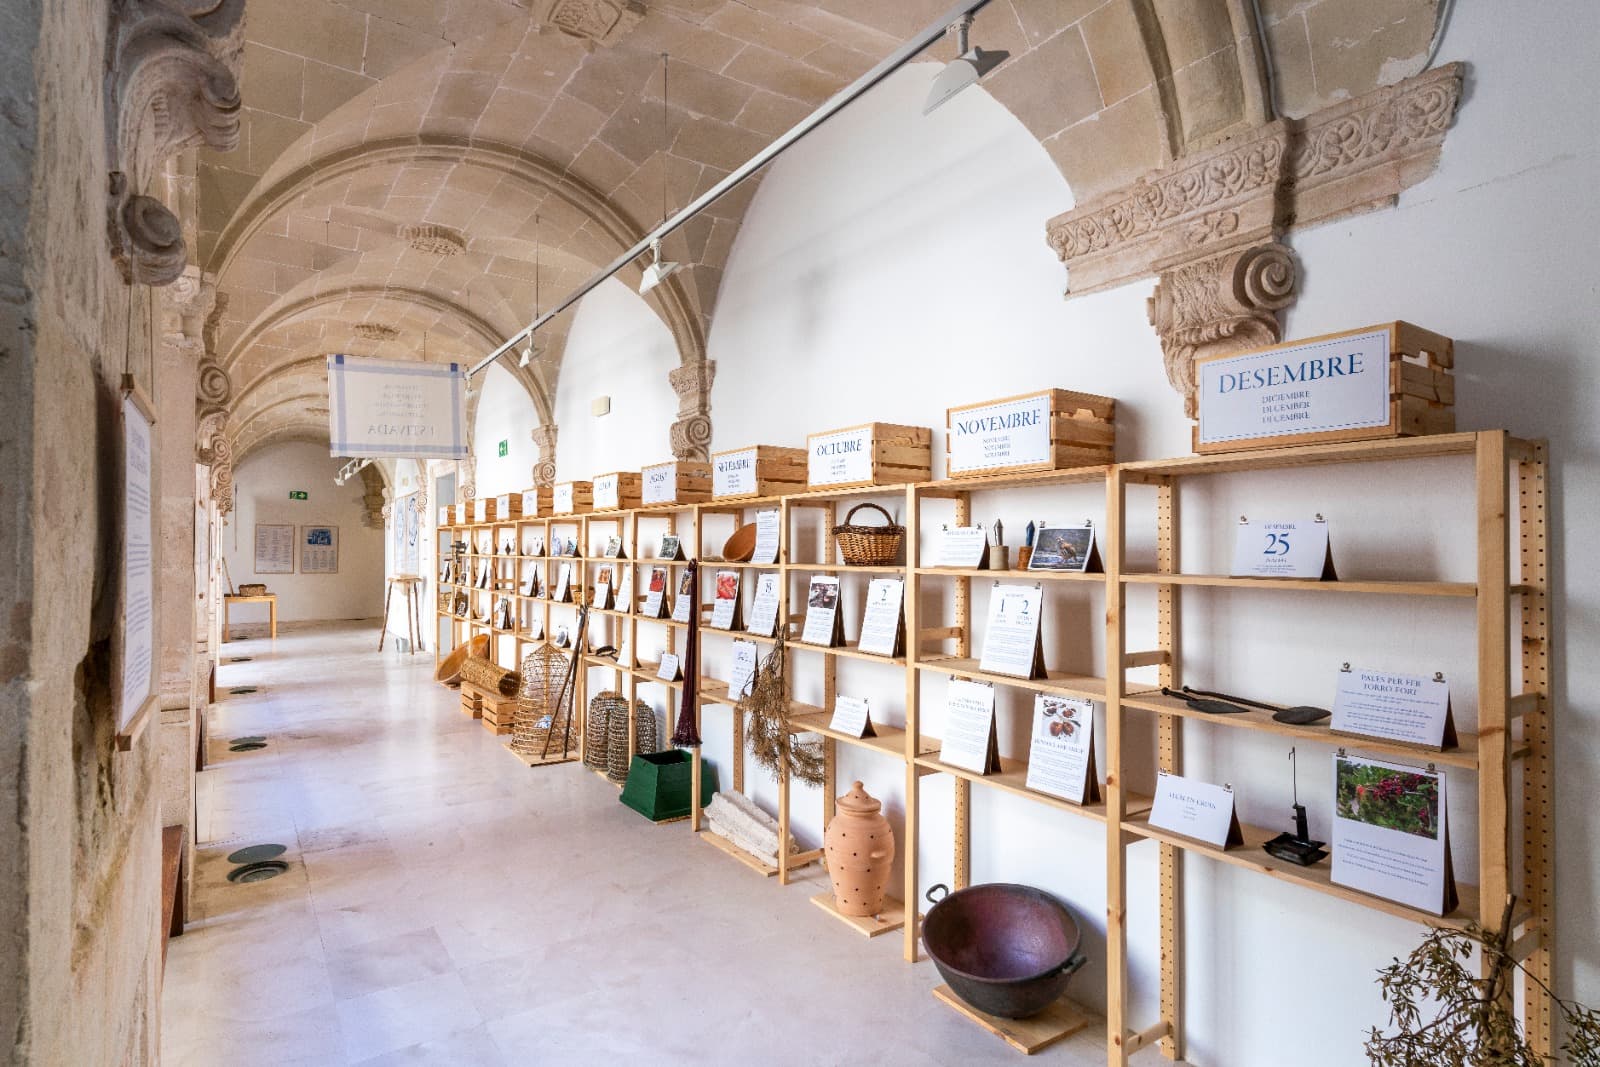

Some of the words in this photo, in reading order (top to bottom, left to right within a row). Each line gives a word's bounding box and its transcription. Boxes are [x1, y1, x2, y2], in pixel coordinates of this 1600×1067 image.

[1219, 352, 1364, 393] DESEMBRE
[957, 408, 1041, 436] NOVEMBRE
[816, 438, 862, 456] OCTUBRE
[1264, 531, 1290, 556] 25
[1000, 597, 1005, 613] 1
[1019, 599, 1029, 615] 2
[1387, 677, 1403, 685] PER
